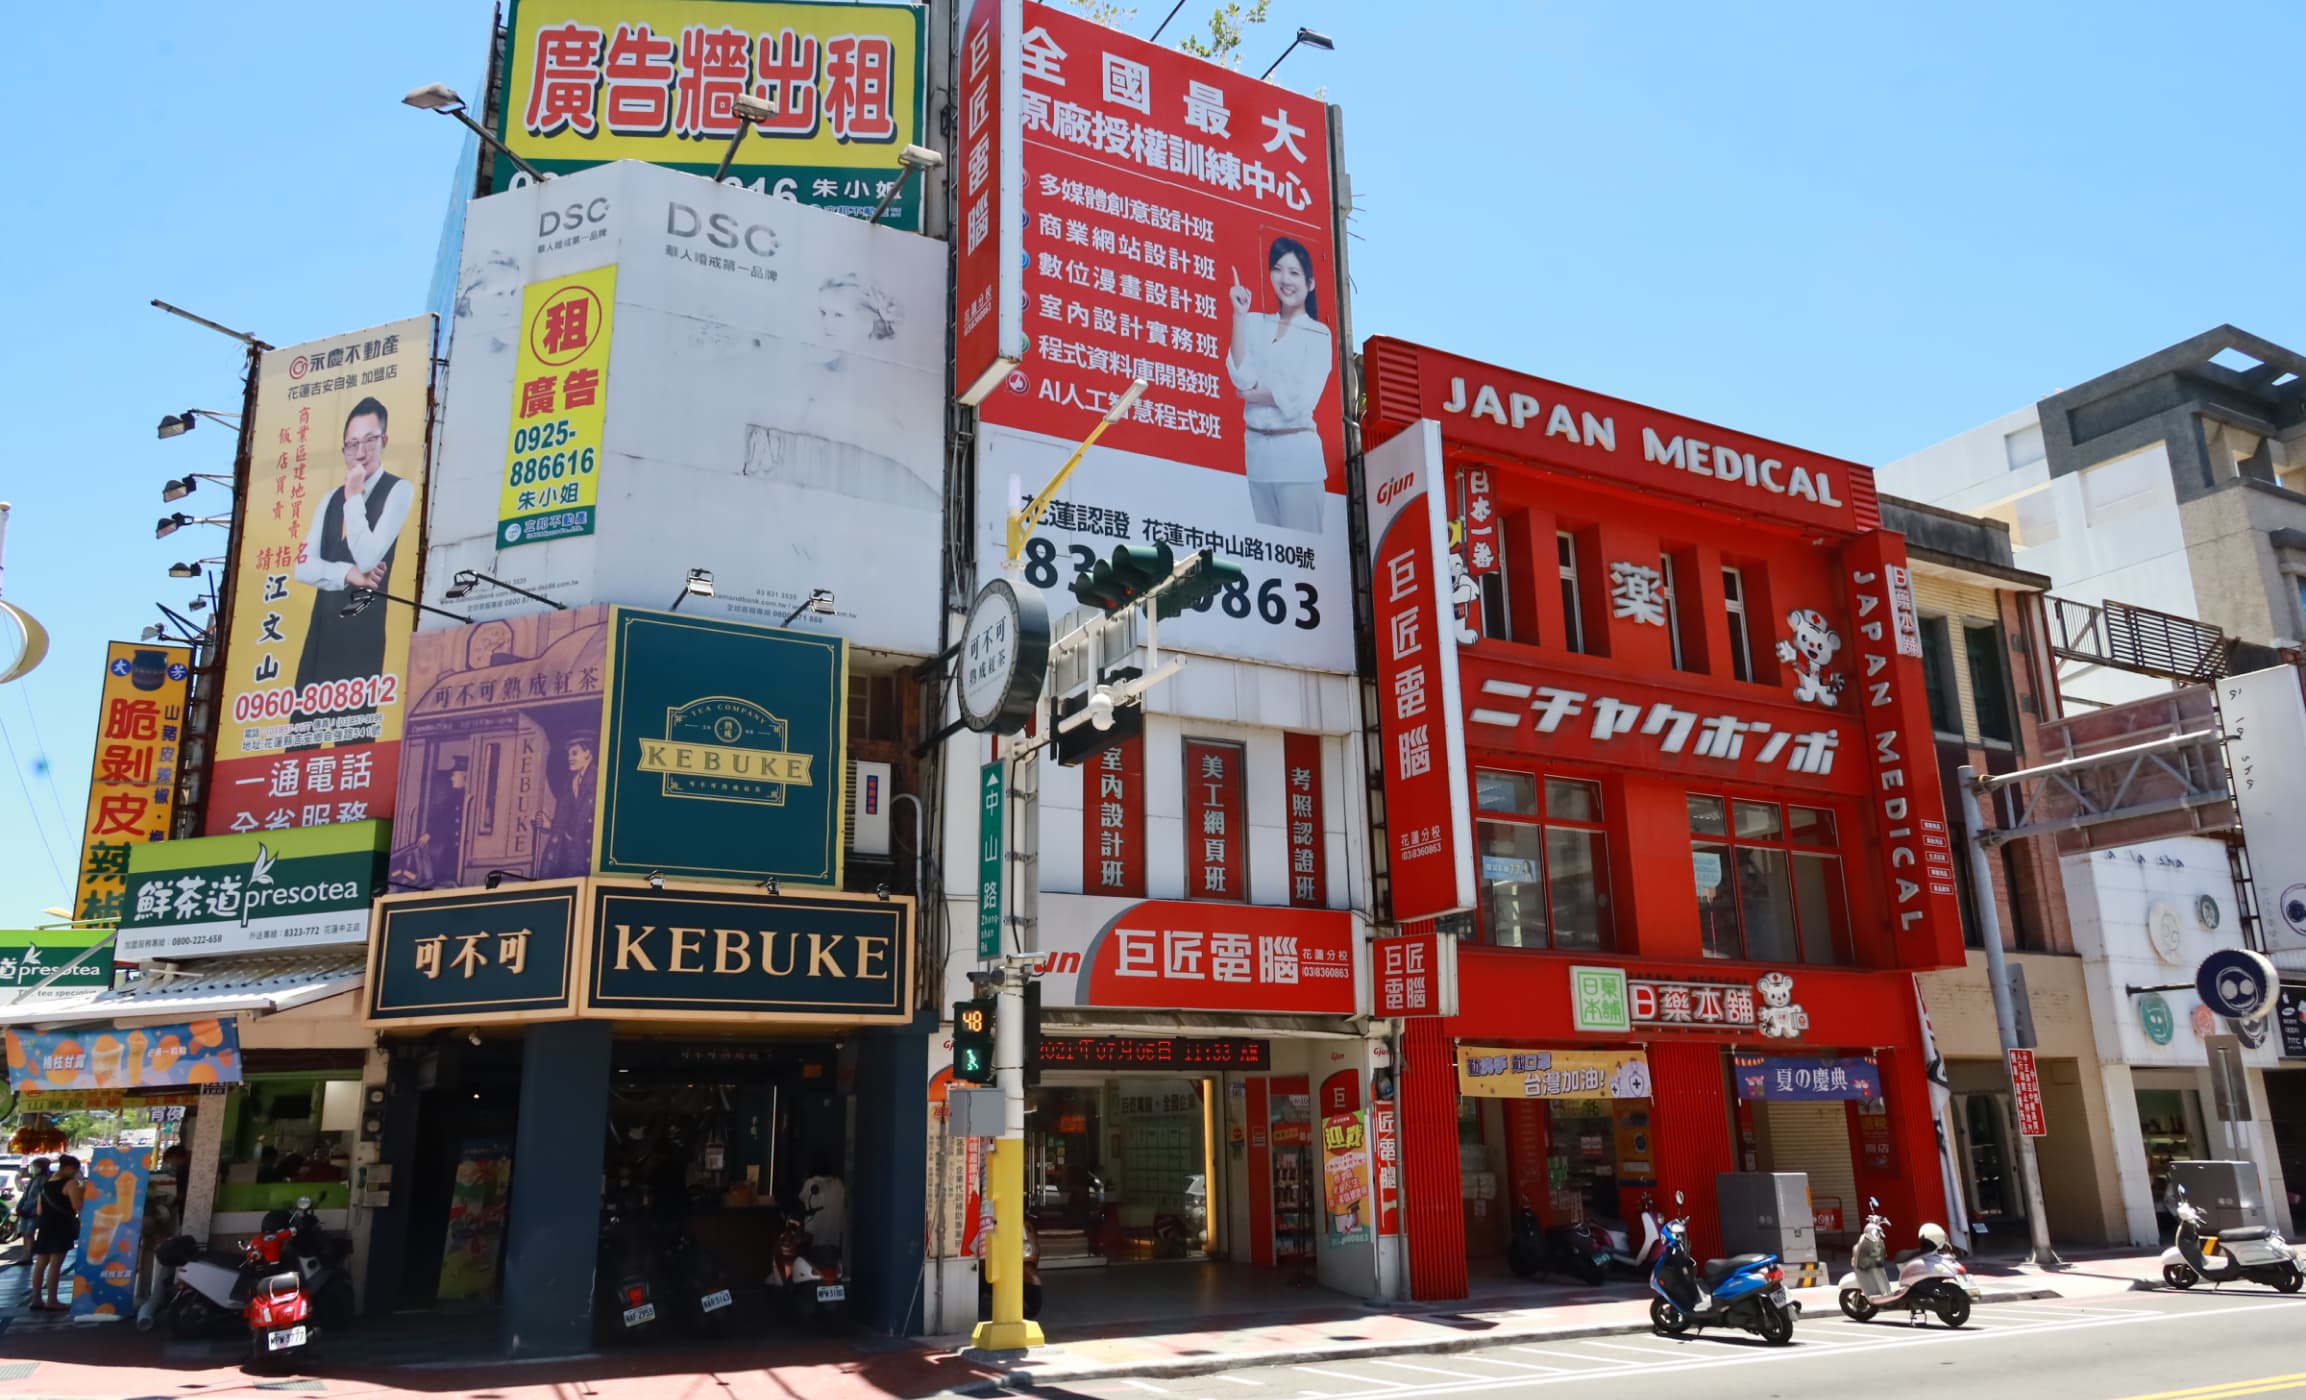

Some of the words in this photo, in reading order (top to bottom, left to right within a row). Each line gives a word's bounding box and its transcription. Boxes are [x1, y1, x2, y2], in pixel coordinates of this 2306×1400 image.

[967, 18, 990, 257] 巨匠電腦
[1022, 88, 1312, 212] 原廠授權訓練中心
[538, 197, 611, 238] DSC
[667, 201, 783, 257] DSC
[1038, 172, 1215, 243] 多媒體創意設計班
[1038, 212, 1216, 282] 商業網站設計班
[1038, 252, 1218, 319] 數位漫畫設計班
[543, 297, 589, 355] 租
[1039, 294, 1219, 359] 室內設計實務班
[310, 334, 400, 373] 永慶不動產
[1038, 335, 1221, 399] 程式資料庫開發班
[519, 368, 599, 419] 廣告
[513, 419, 577, 455] 0925-
[1442, 376, 1617, 452] JAPAN
[1641, 426, 1843, 508] MEDICAL
[509, 447, 594, 488] 886616
[1376, 472, 1415, 507] Gjun
[517, 482, 578, 511] 朱小姐
[1470, 470, 1494, 569] 日本一番
[255, 542, 309, 571] 請指名
[1142, 518, 1316, 571] 花蓮市中山路180號
[1024, 537, 1321, 630] 83863
[255, 574, 289, 683] 江文山
[970, 615, 1007, 661] 可不可
[113, 660, 128, 676] 大
[435, 667, 598, 708] 可不可熟成紅茶
[1387, 548, 1431, 781] 巨匠電腦
[235, 675, 397, 722] 0960-808812
[690, 705, 712, 718] TEA
[717, 703, 767, 726] COMPANY
[1469, 679, 1839, 776] ニチヤクホンポ
[1853, 571, 1893, 707] JAPAN
[1876, 730, 1924, 931] MEDICAL
[235, 752, 373, 798] 一通電話
[648, 745, 803, 779] KEBUKE
[514, 737, 535, 852] KEBUKE
[1099, 746, 1125, 888] 室內設計班
[983, 789, 999, 910] 中山路
[1202, 754, 1227, 893] 美工網頁班
[1291, 767, 1315, 902] 考照認證班
[133, 875, 242, 921] 鮮茶道
[241, 881, 359, 928] presotea
[415, 928, 532, 980] 可不可
[614, 924, 890, 980] KEBUKE
[1114, 928, 1300, 985] 巨匠電腦
[1384, 943, 1425, 975] 巨匠
[1385, 976, 1426, 1009] 電腦
[1629, 983, 1754, 1024] 日藥本舖
[962, 1010, 982, 1032] 48
[1333, 1087, 1345, 1108] 巨
[1524, 1068, 1606, 1096] 台灣加油!
[1776, 1067, 1849, 1093] 夏の慶典
